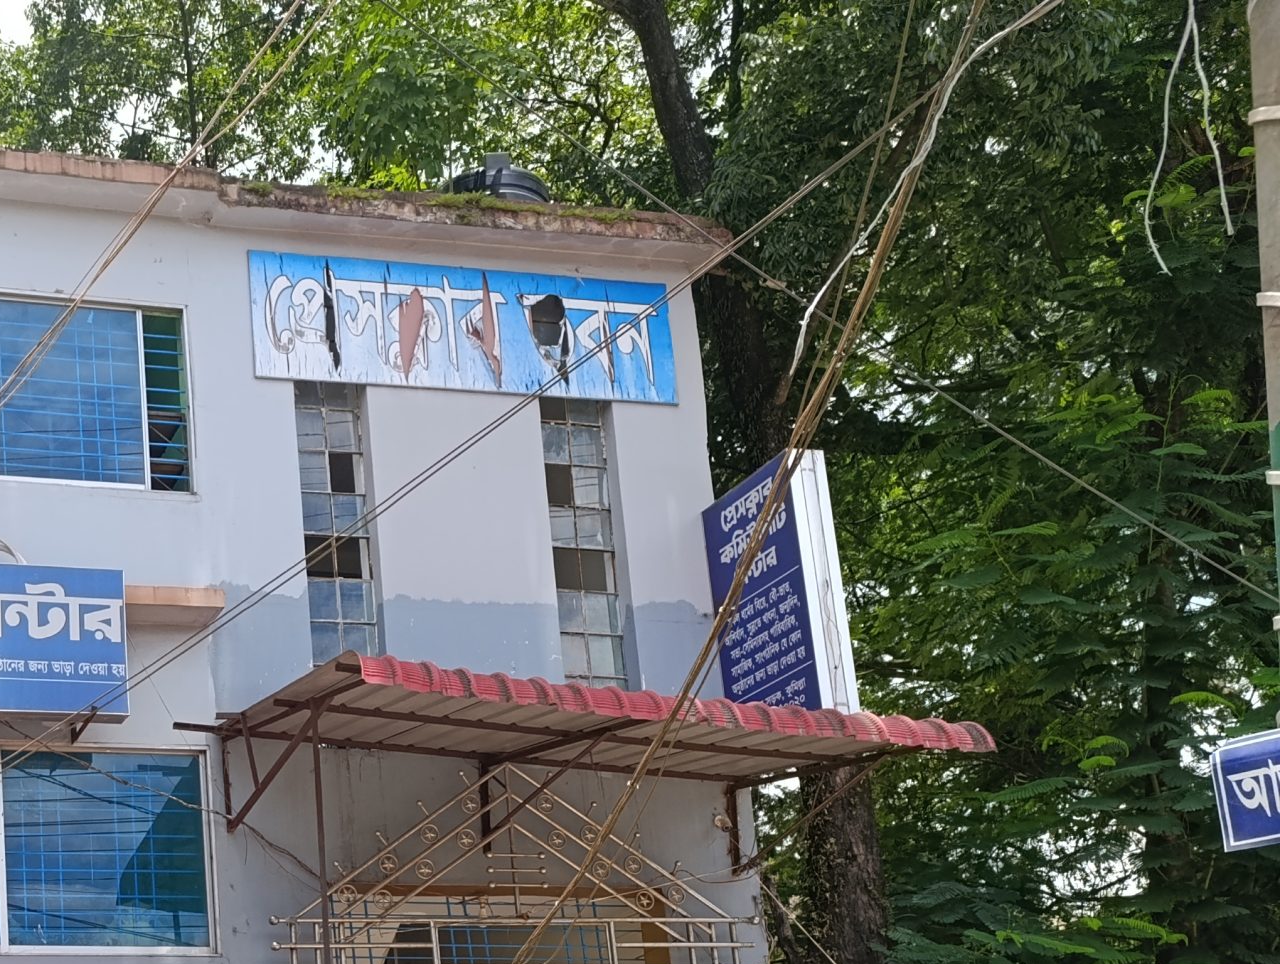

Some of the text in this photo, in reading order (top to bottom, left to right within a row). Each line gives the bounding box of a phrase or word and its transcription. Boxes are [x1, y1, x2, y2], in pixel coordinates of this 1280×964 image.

[27, 660, 48, 673] জন্য
[52, 660, 75, 677] ভাড়া
[78, 661, 108, 677] দেওয়া
[111, 663, 125, 678] হয়
